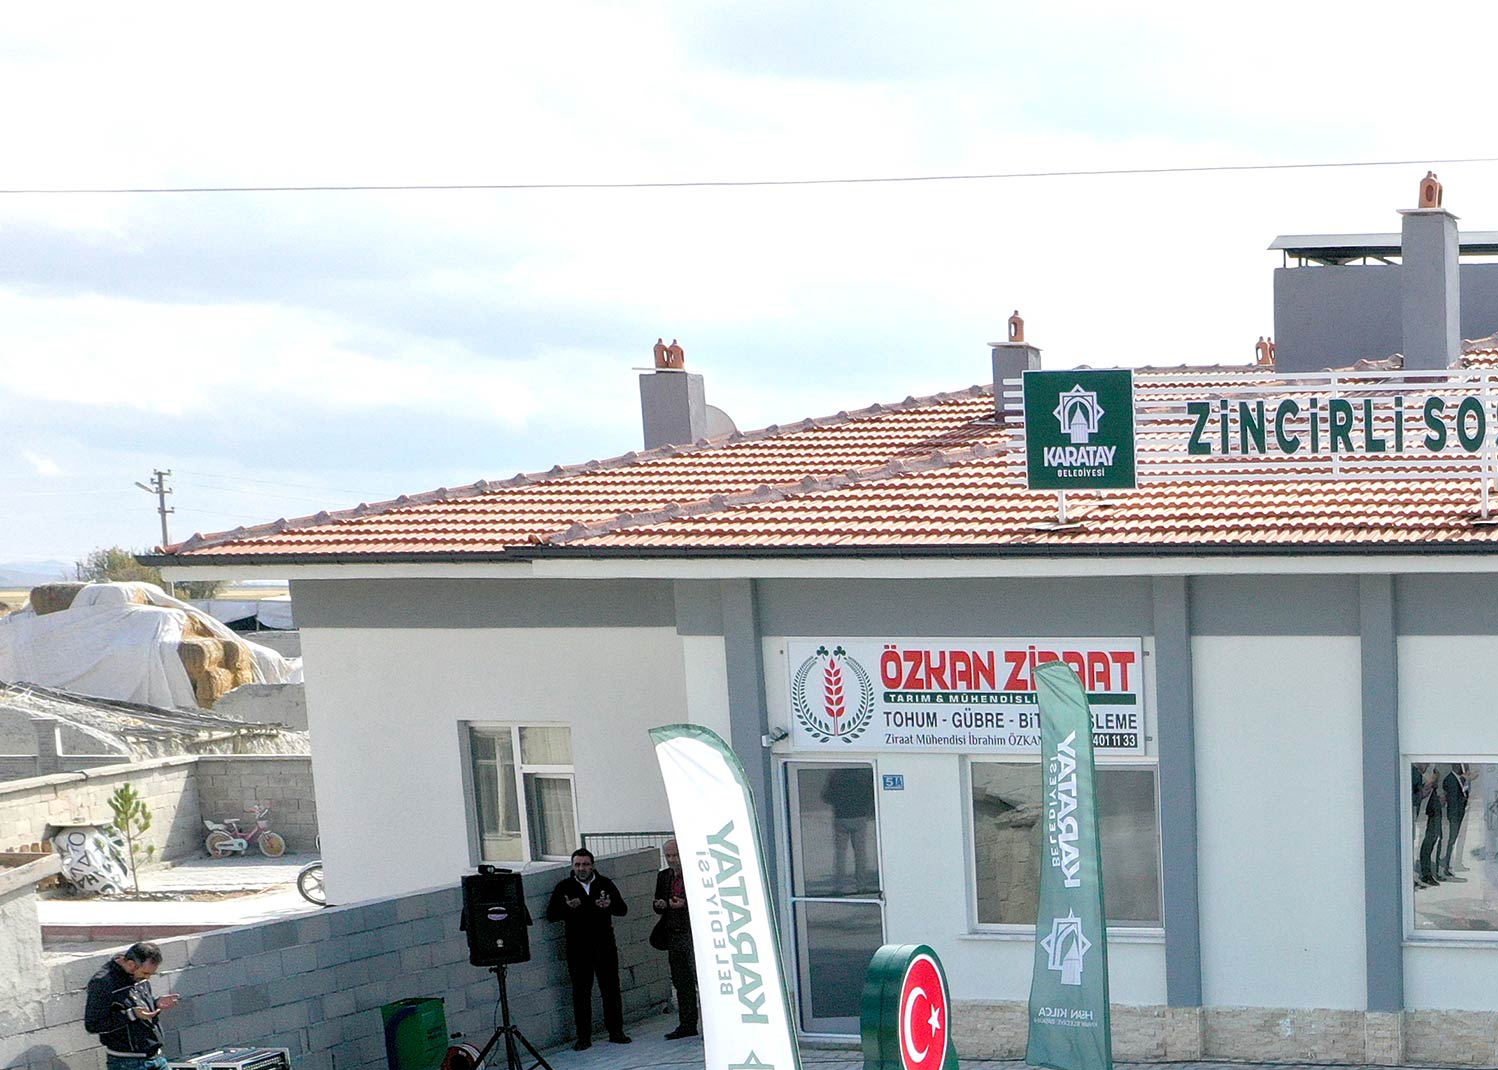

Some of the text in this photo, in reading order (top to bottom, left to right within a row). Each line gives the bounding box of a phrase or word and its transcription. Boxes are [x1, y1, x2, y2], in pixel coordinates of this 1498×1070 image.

[1043, 445, 1117, 467] KARATAY
[880, 645, 996, 690] ÖZKAN
[889, 693, 1037, 703] TARIM & MÜHENDİSLİ
[884, 711, 938, 728] TOHUM
[952, 707, 1005, 728] GÜBRE
[885, 733, 914, 745] Ziraat
[916, 733, 967, 746] Mühendisi
[1123, 735, 1136, 747] 33
